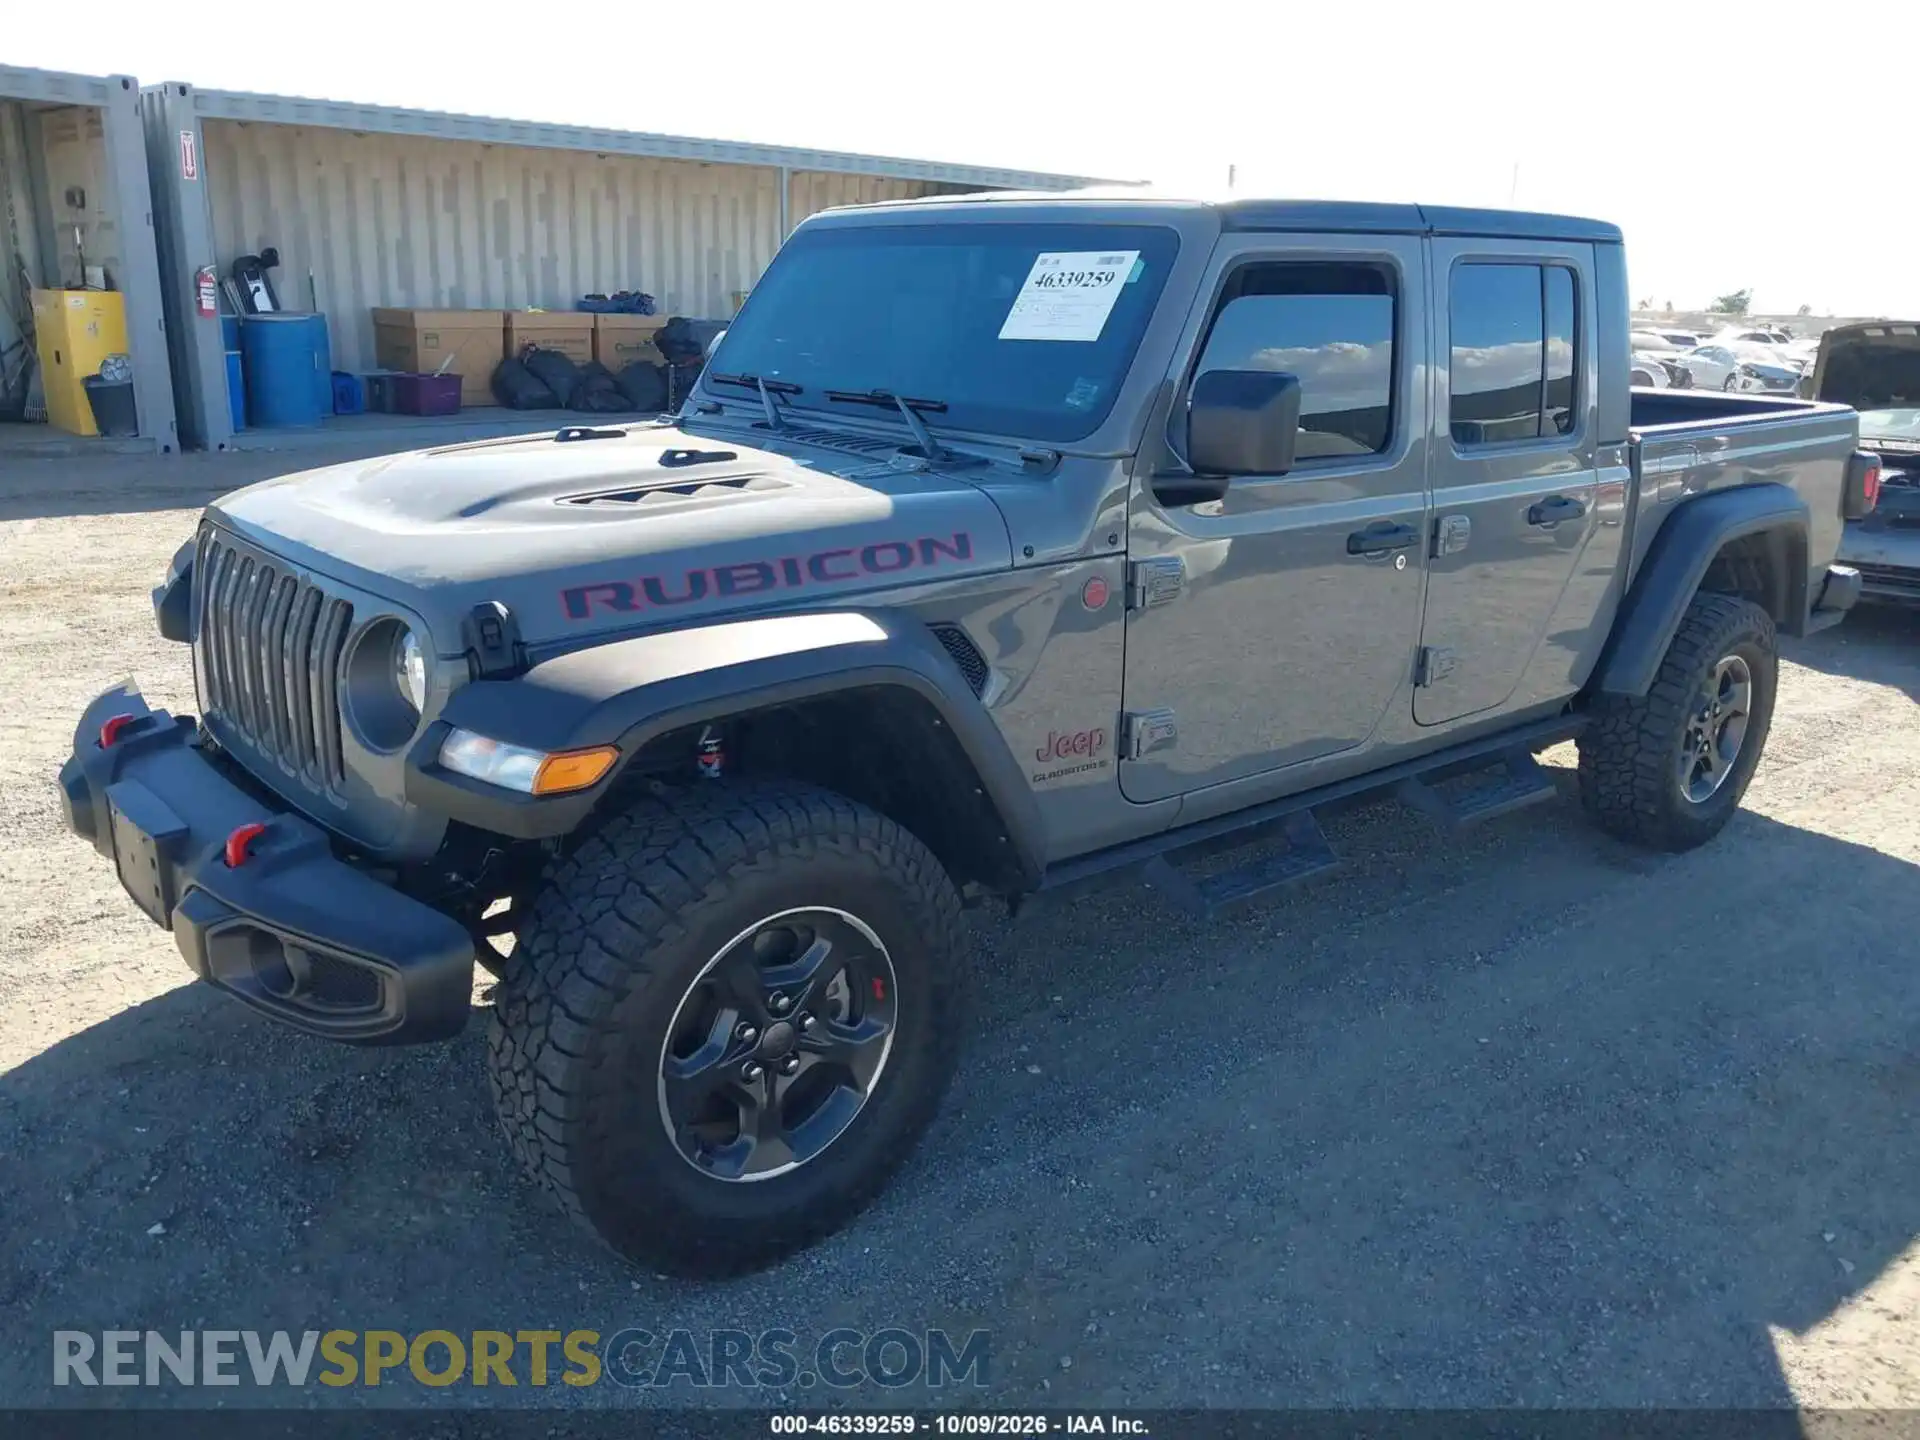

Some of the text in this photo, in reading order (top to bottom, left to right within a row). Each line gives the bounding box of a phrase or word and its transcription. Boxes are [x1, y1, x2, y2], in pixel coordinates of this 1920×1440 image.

[1034, 271, 1116, 288] 46339259
[560, 532, 973, 620] RUBICON
[1036, 728, 1105, 763] Jeep
